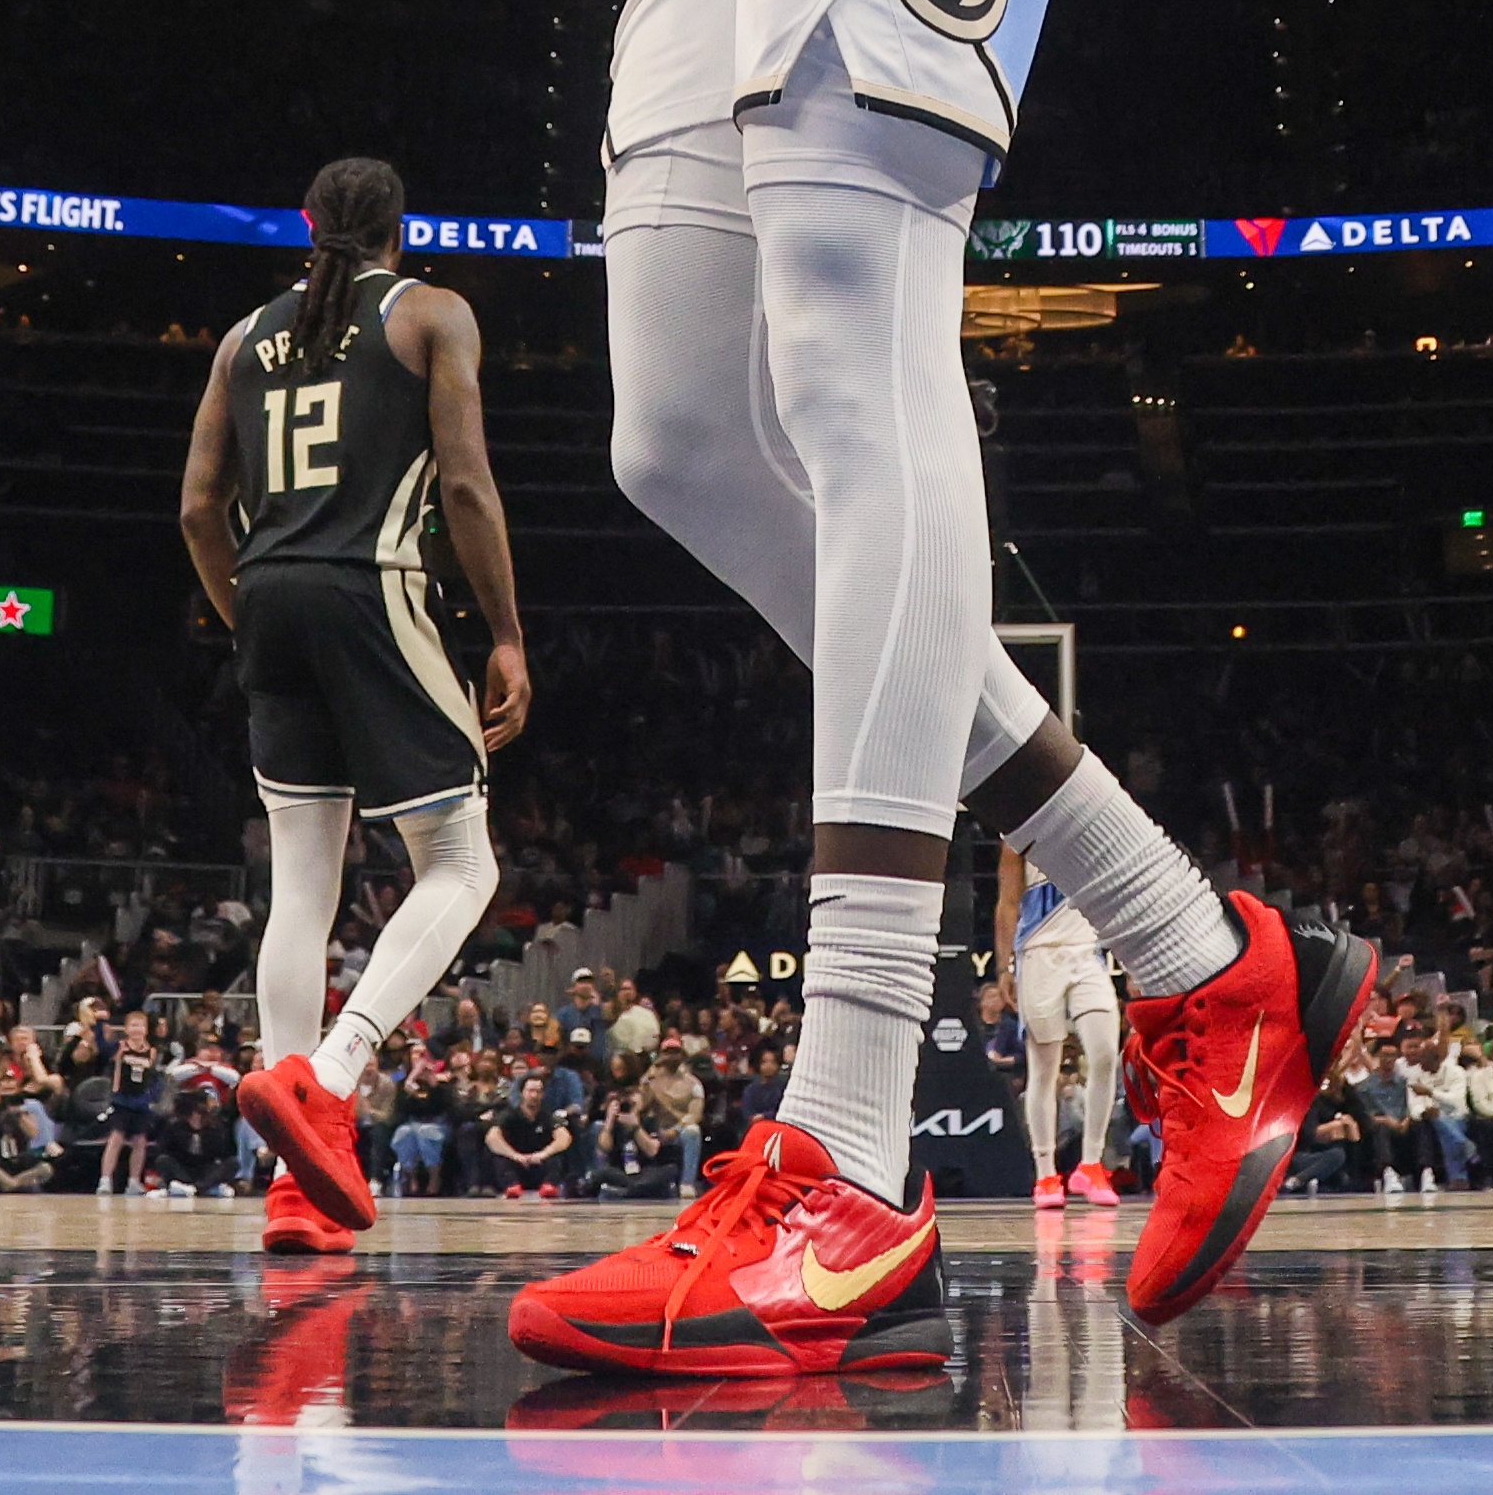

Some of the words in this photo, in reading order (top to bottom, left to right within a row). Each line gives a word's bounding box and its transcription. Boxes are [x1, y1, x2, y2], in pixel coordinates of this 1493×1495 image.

[20, 191, 125, 231] FLIGHT.
[408, 220, 538, 251] DELTA
[1035, 221, 1103, 257] 110
[1115, 223, 1136, 237] FLS
[1137, 223, 1148, 237] 4
[1151, 223, 1199, 237] BONUS
[1116, 242, 1183, 256] TIMEOUTS
[1188, 242, 1197, 256] 1
[1340, 214, 1473, 249] DELTA
[255, 325, 361, 374] PRE
[263, 381, 342, 494] 12
